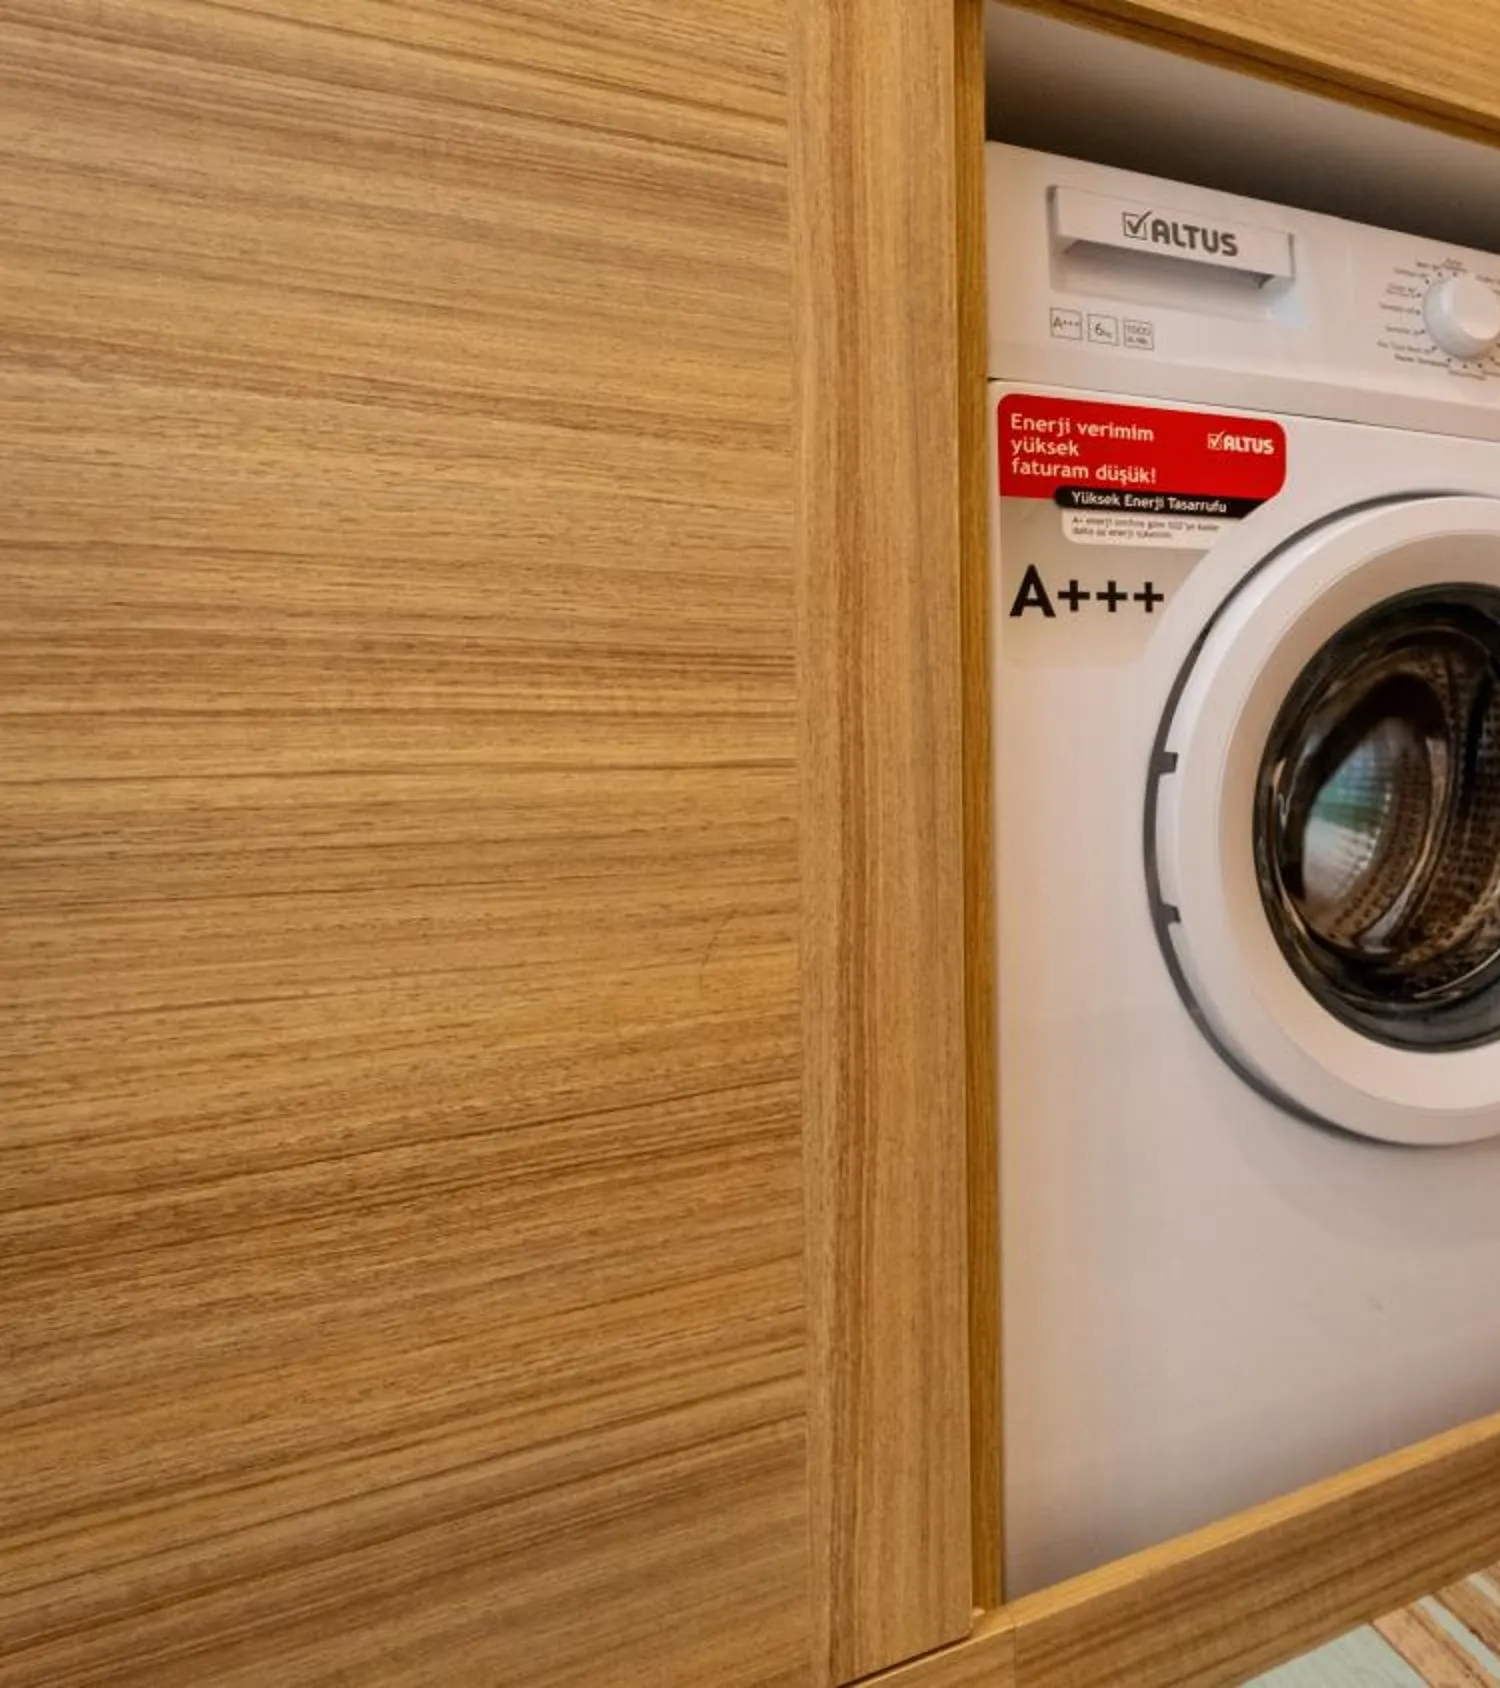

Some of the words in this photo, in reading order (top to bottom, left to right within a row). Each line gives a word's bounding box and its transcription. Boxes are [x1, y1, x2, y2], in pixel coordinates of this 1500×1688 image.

[1151, 218, 1239, 257] ALTUS
[1011, 413, 1072, 437] Enerji
[1077, 422, 1154, 442] verimim
[1011, 437, 1080, 457] yüksek
[1223, 433, 1275, 455] ALTUS
[1011, 459, 1089, 478] faturam
[1095, 464, 1157, 486] düşük!
[1071, 491, 1121, 507] Yüksek
[1124, 494, 1164, 511] Enerji
[1168, 498, 1227, 513] Tasarrufu
[1008, 563, 1165, 618] A+++
